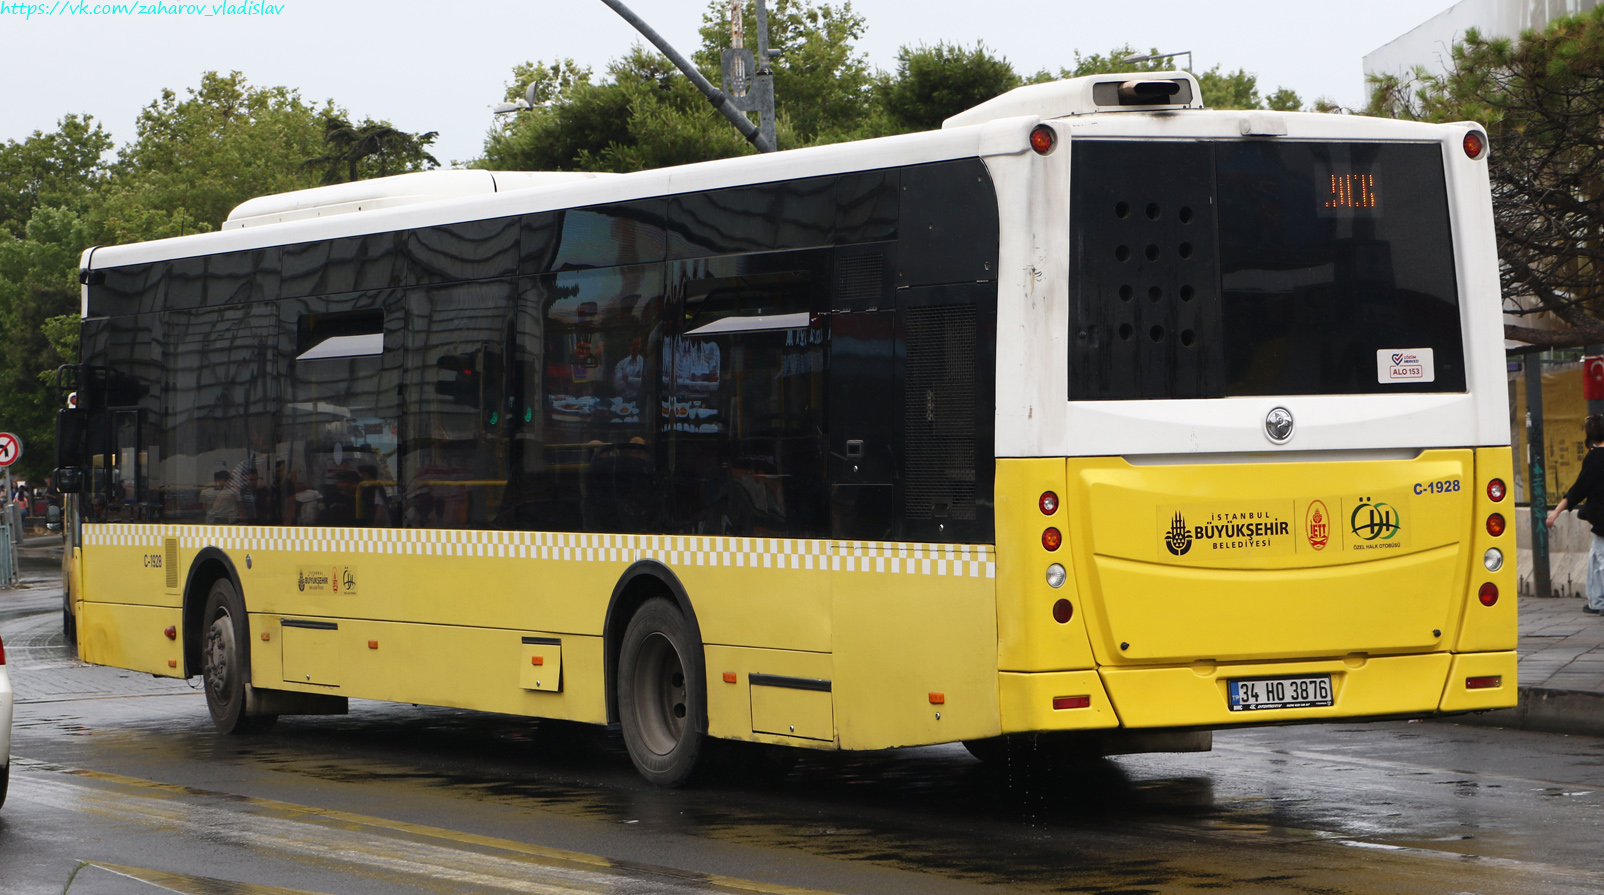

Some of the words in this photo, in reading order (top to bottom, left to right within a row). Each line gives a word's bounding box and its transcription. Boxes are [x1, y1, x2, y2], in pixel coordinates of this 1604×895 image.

[1393, 368, 1408, 376] ALO
[1413, 479, 1461, 495] C-1928
[1211, 512, 1270, 521] İSTANBUL
[1194, 518, 1290, 541] BÜYÜKŞEHİR
[1212, 538, 1271, 549] BELEDİYESİ
[144, 554, 163, 568] C-1928
[1240, 683, 1260, 702] 34
[1266, 682, 1286, 701] HO
[1290, 680, 1328, 700] 3876
